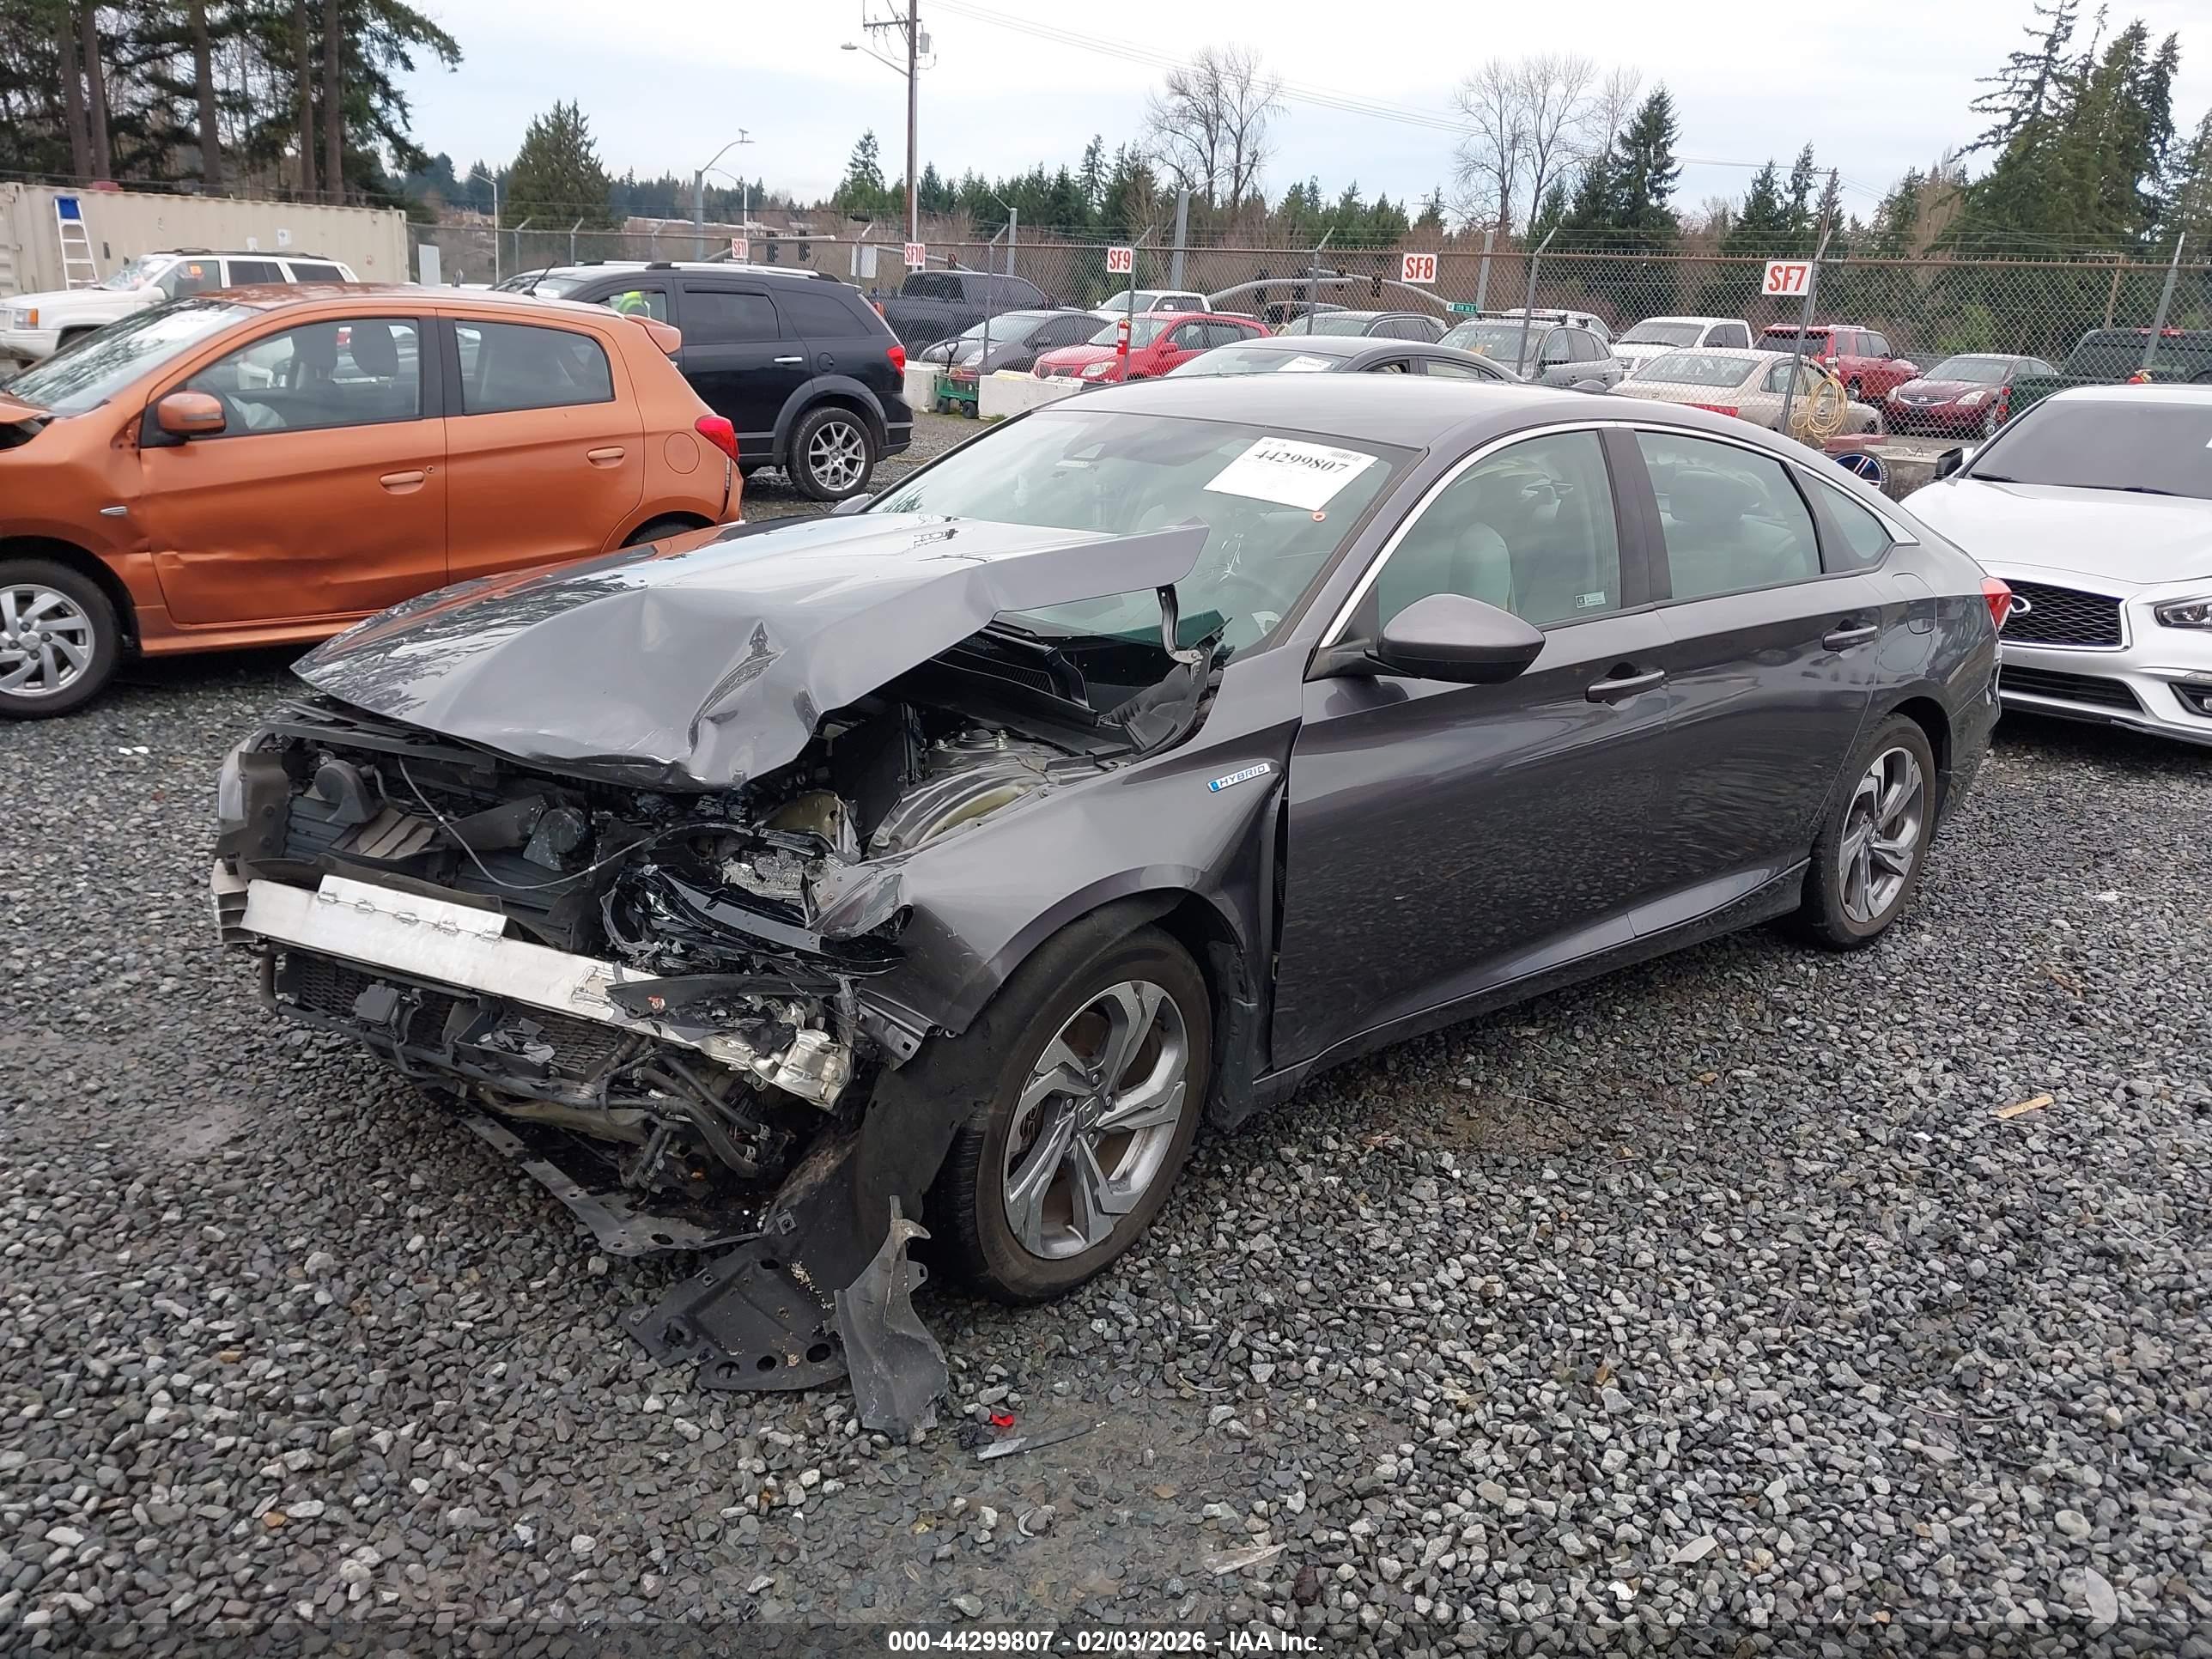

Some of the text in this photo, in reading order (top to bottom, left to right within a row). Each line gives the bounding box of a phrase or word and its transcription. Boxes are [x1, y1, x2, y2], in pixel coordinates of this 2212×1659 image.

[906, 246, 924, 263] SF10
[1109, 250, 1131, 270] SF9
[1405, 257, 1434, 279] SF8
[1768, 265, 1808, 292] SF7
[1253, 449, 1349, 474] 44299807
[1219, 765, 1266, 787] HYBRID
